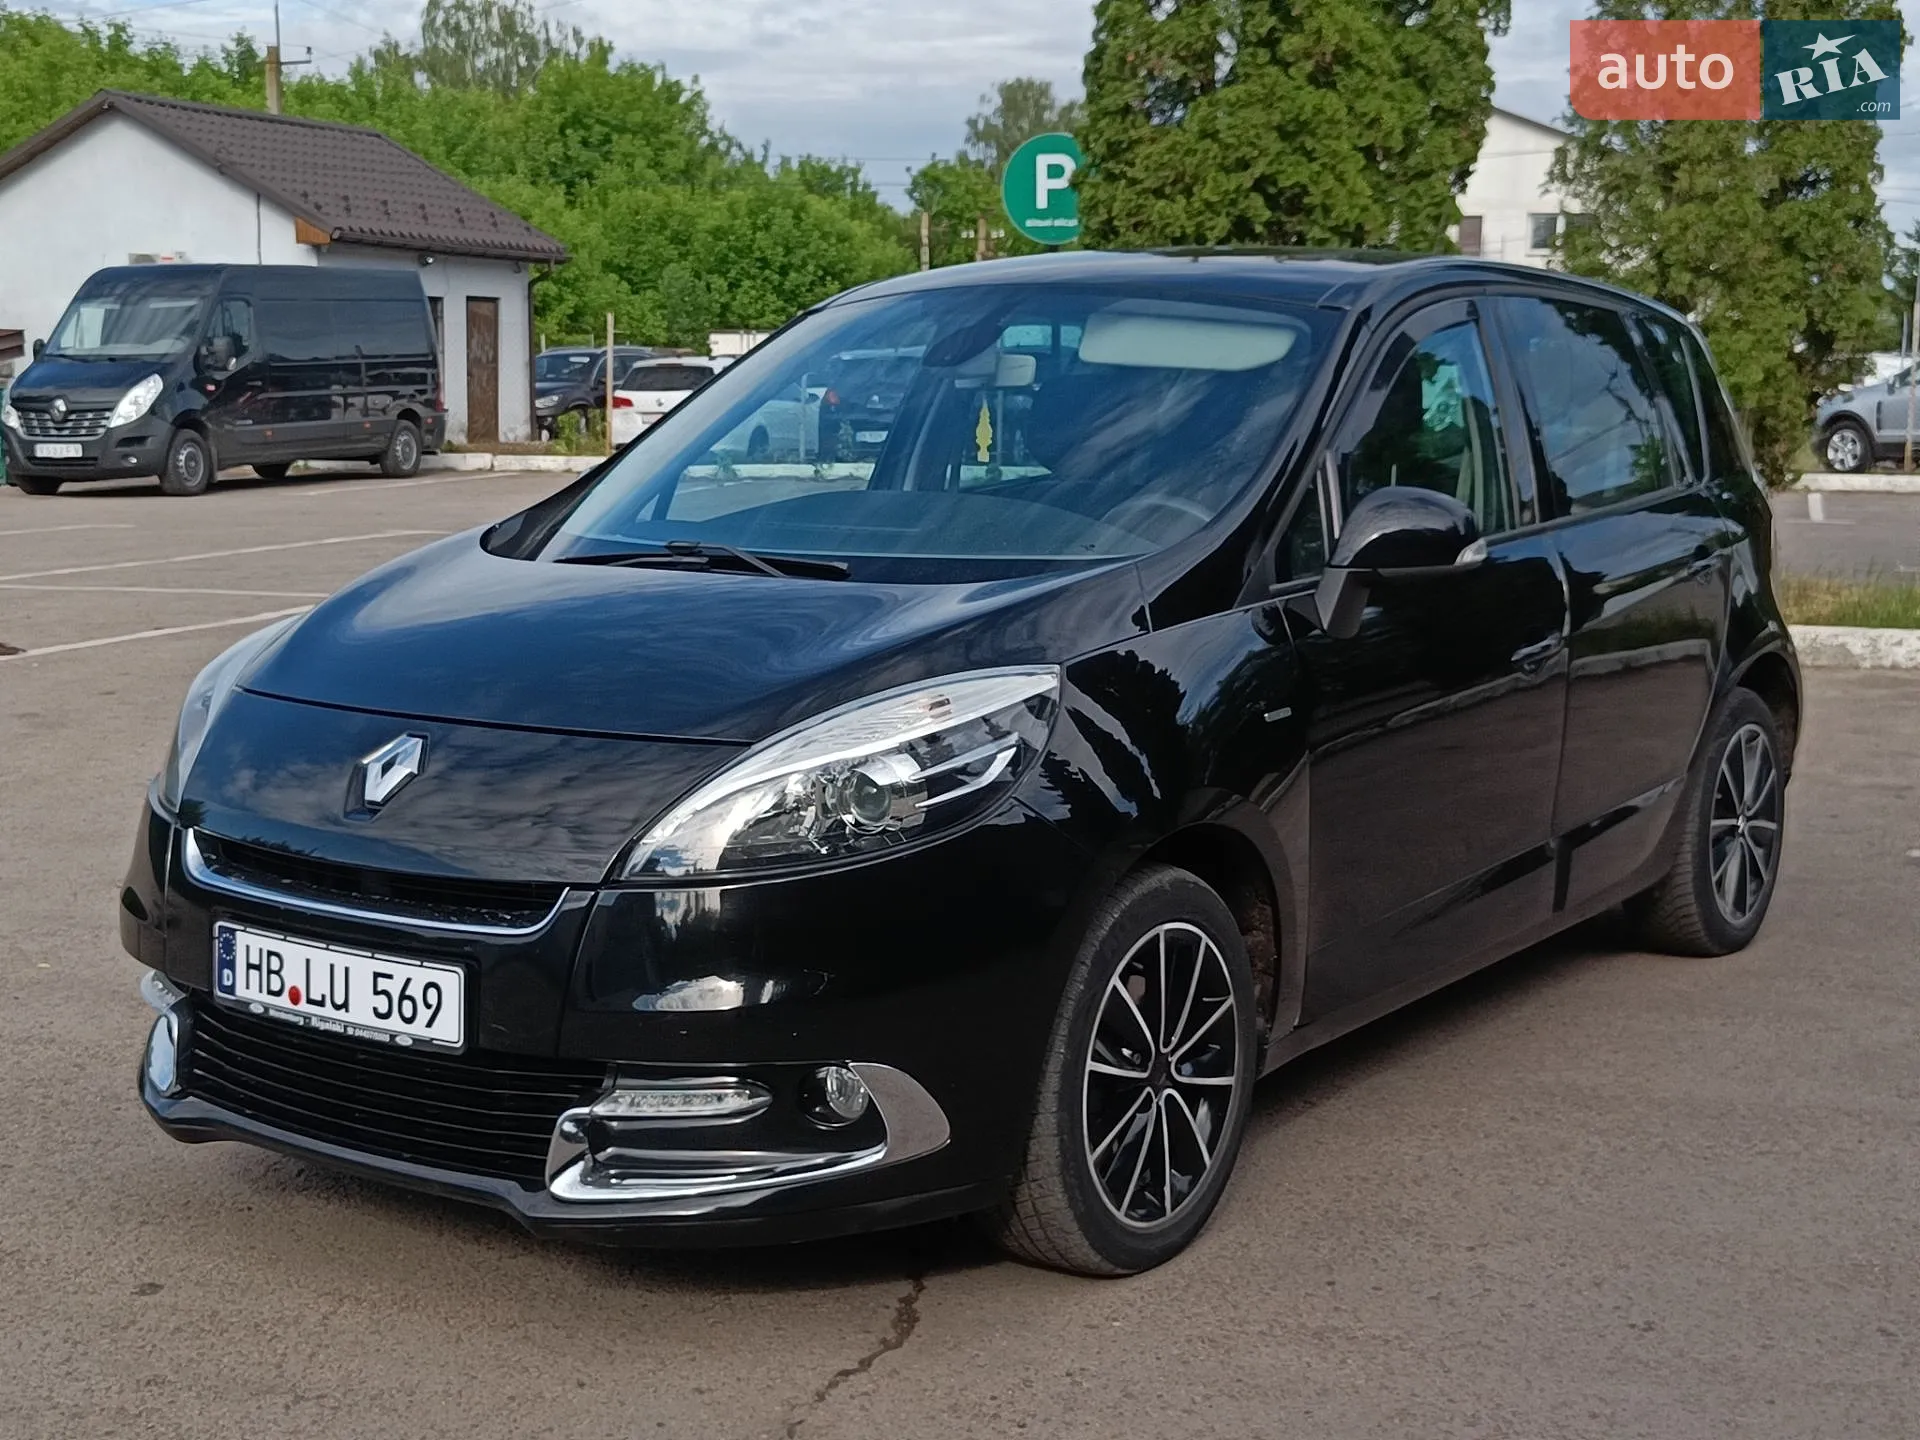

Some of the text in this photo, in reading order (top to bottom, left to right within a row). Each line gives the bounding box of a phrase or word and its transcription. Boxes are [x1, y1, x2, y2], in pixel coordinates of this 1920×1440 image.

[1036, 153, 1077, 209] P
[222, 969, 234, 987] D
[245, 944, 286, 998] HB
[305, 958, 350, 1013] LU
[372, 971, 443, 1029] 569
